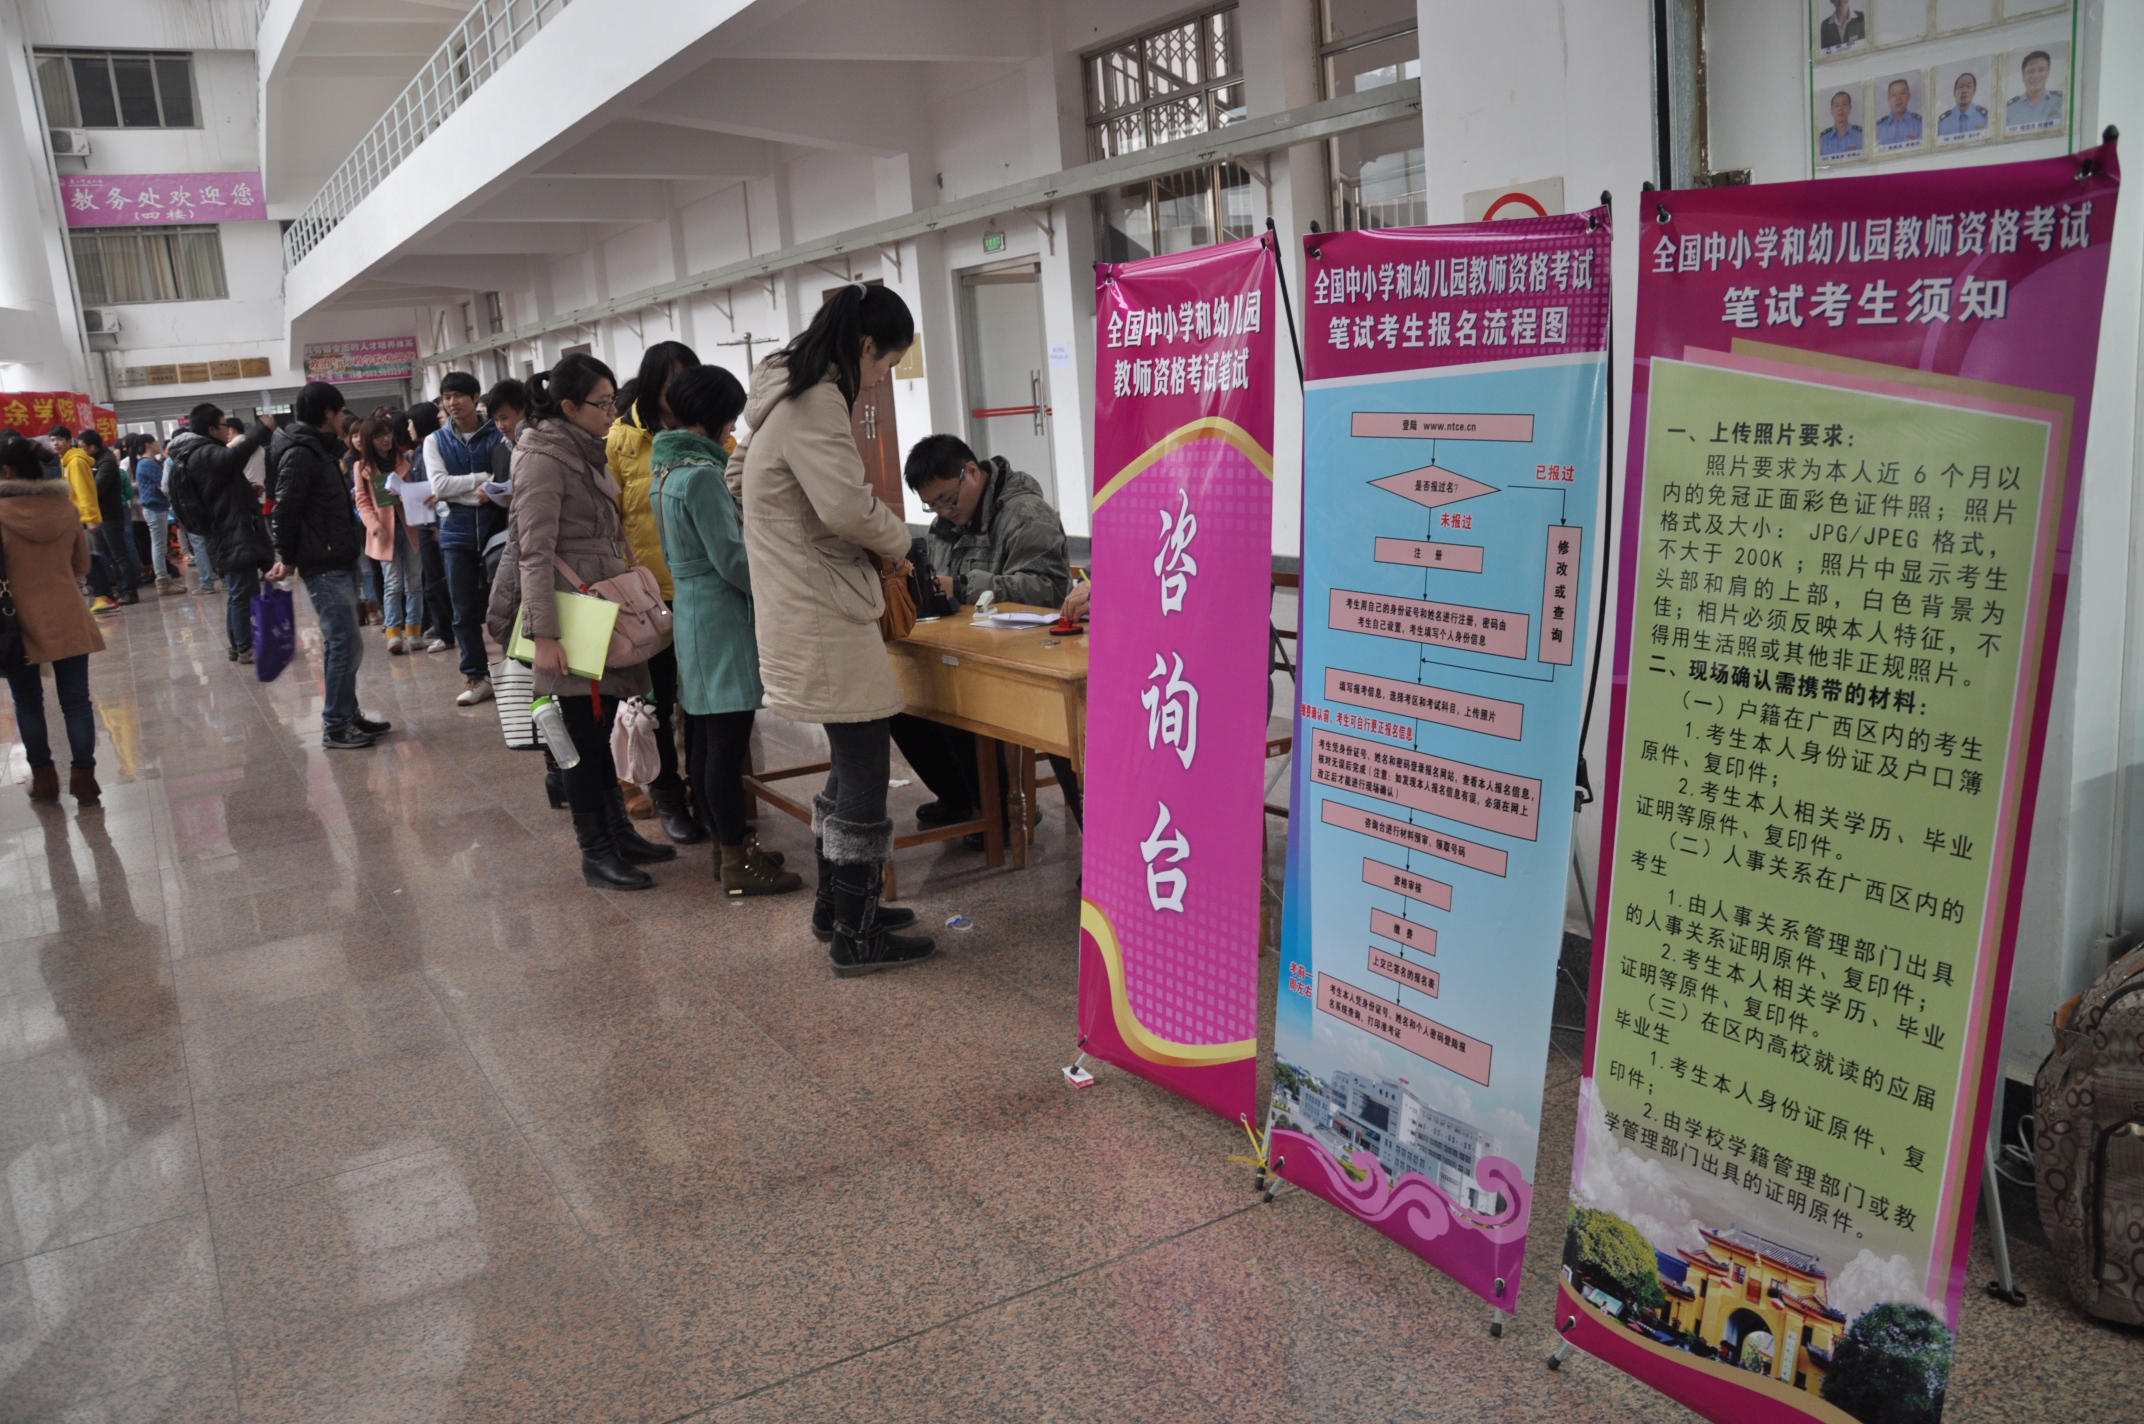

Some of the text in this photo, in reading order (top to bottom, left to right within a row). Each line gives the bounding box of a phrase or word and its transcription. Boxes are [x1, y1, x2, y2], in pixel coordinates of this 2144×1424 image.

[70, 182, 255, 211] 教务处欢迎您
[1652, 201, 2094, 274] 全国中小学和幼儿园教师资格考试
[1313, 248, 1594, 305] 全国中小学和幼儿园教师资格考试
[1722, 275, 2009, 329] 笔试考生须知
[1107, 289, 1262, 348] 全国中小学和幼儿园
[1328, 306, 1570, 350] 笔试考生报名流程图
[1113, 347, 1250, 398] 教师资格考试笔试
[1423, 422, 1476, 432] www.ntce.cn
[1667, 422, 1856, 448] 一、上传照片要求：
[1535, 465, 1575, 482] 已报过
[1662, 482, 2019, 525] 内的免冠正面彩色证件照；照片
[1440, 513, 1473, 529] 未报过
[1551, 540, 1570, 643] 修改或查询
[1655, 567, 2006, 626] 头部和肩的上部，白色背景为
[1650, 625, 1973, 688] 得用生活照或其他非正规照片。
[1653, 596, 2002, 657] 佳；相片必须反映本人特征，不
[1139, 487, 1199, 913] 咨询台
[1649, 655, 1927, 716] 二、现场确认需携带的材料：
[1683, 691, 1984, 762] （一）户籍在广西区内的考生
[1641, 739, 1781, 788] 原件、复印件；
[1685, 722, 1984, 797] 1.考生本人身份证及户口簿
[1636, 796, 1846, 861] 证明等原件、复印件。
[1678, 778, 1974, 861] 2.考生本人相关学历、毕业
[1394, 875, 1422, 894] 资格审核
[1631, 850, 1668, 876] 考生
[1670, 831, 1966, 924] （二）人事关系在广西区内的
[1625, 903, 1927, 1013] 的人事关系证明原件、复印件；
[1668, 889, 1955, 987] 1.由人事关系管理部门出具
[1372, 955, 1436, 990] 上交已签名的报名表
[1620, 956, 1824, 1039] 证明等原件、复印件。
[1661, 944, 1946, 1050] 2.考生本人相关学历、毕业
[1614, 1008, 1671, 1045] 毕业生
[1648, 992, 1937, 1111] （三）在区内高校就读的应届
[1609, 1061, 1655, 1096] 印件；
[1650, 1051, 1927, 1173] 1.考生本人身份证原件、复
[1603, 1111, 1865, 1240] 学管理部门出具的证明原件。
[1643, 1103, 1918, 1232] 2.由学校学籍管理部门或教
